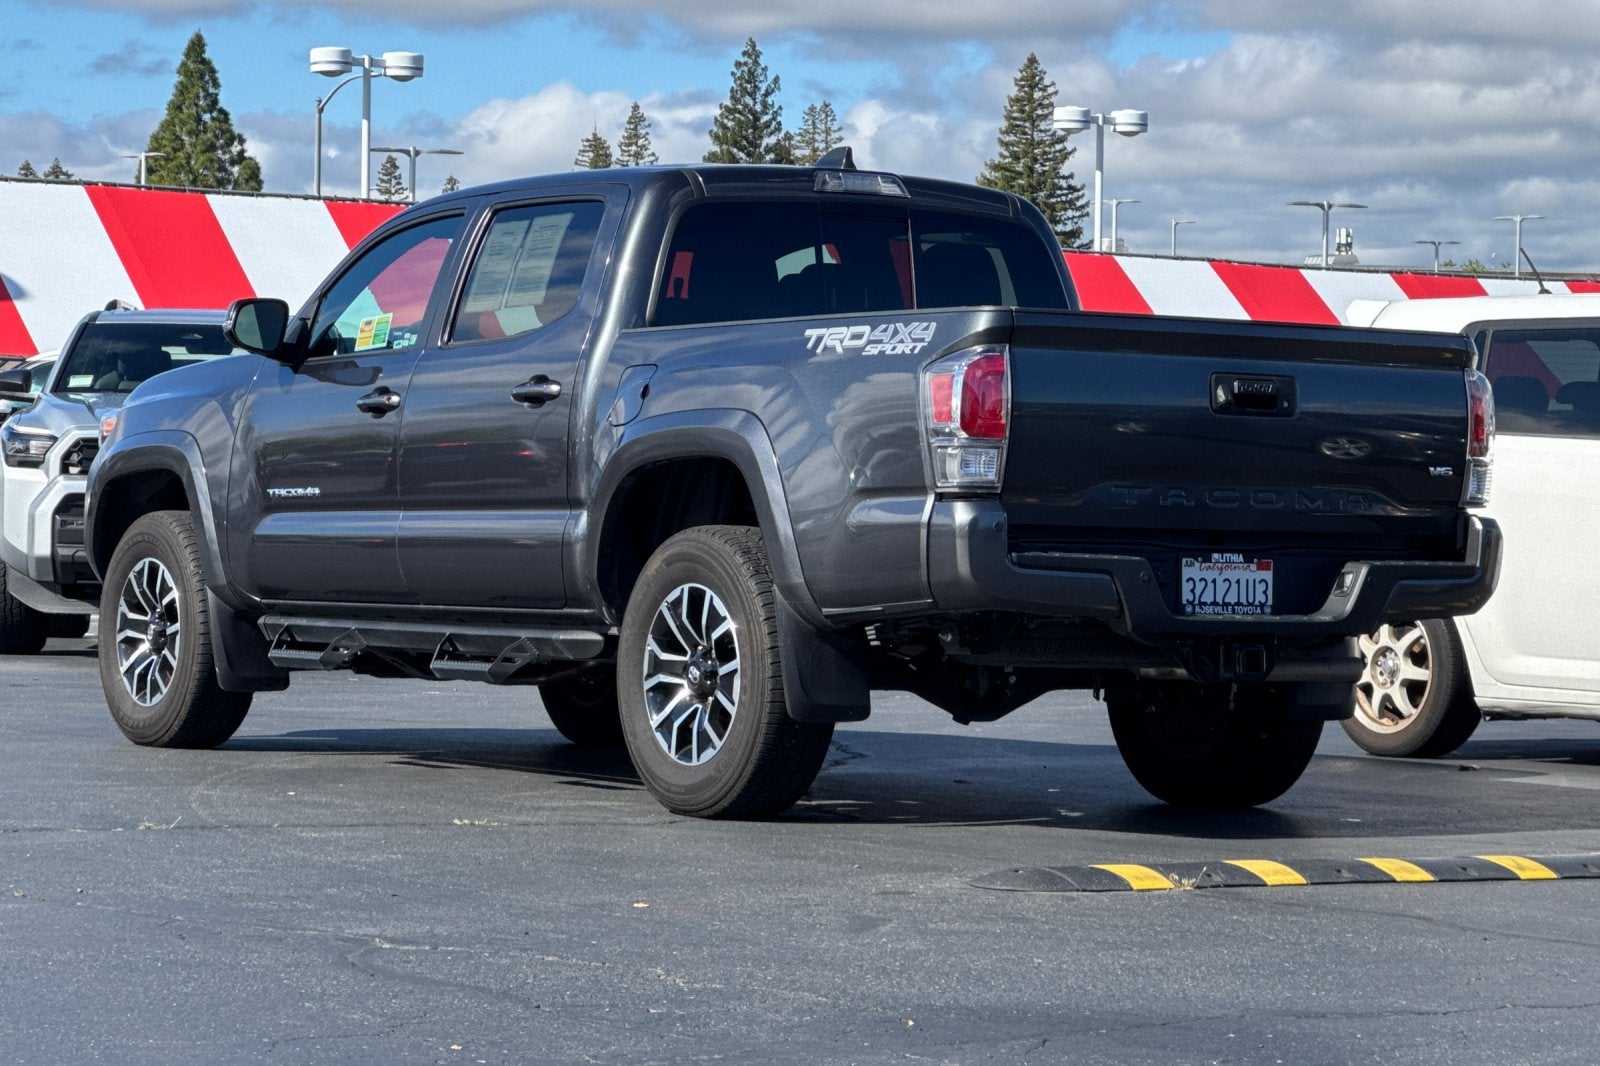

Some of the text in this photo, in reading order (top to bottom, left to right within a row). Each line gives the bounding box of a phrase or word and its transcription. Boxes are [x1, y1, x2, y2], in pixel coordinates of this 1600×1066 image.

[804, 321, 937, 355] TRD 4X4
[862, 342, 929, 356] SPORT
[1428, 466, 1454, 477] V6
[266, 486, 321, 498] TACOMA
[1110, 486, 1375, 512] TACOMA
[1220, 553, 1244, 562] LITHIA
[1199, 563, 1256, 575] California
[1185, 577, 1269, 604] 32121U3
[1195, 605, 1261, 614] ROSEVILLE TOYOTA
